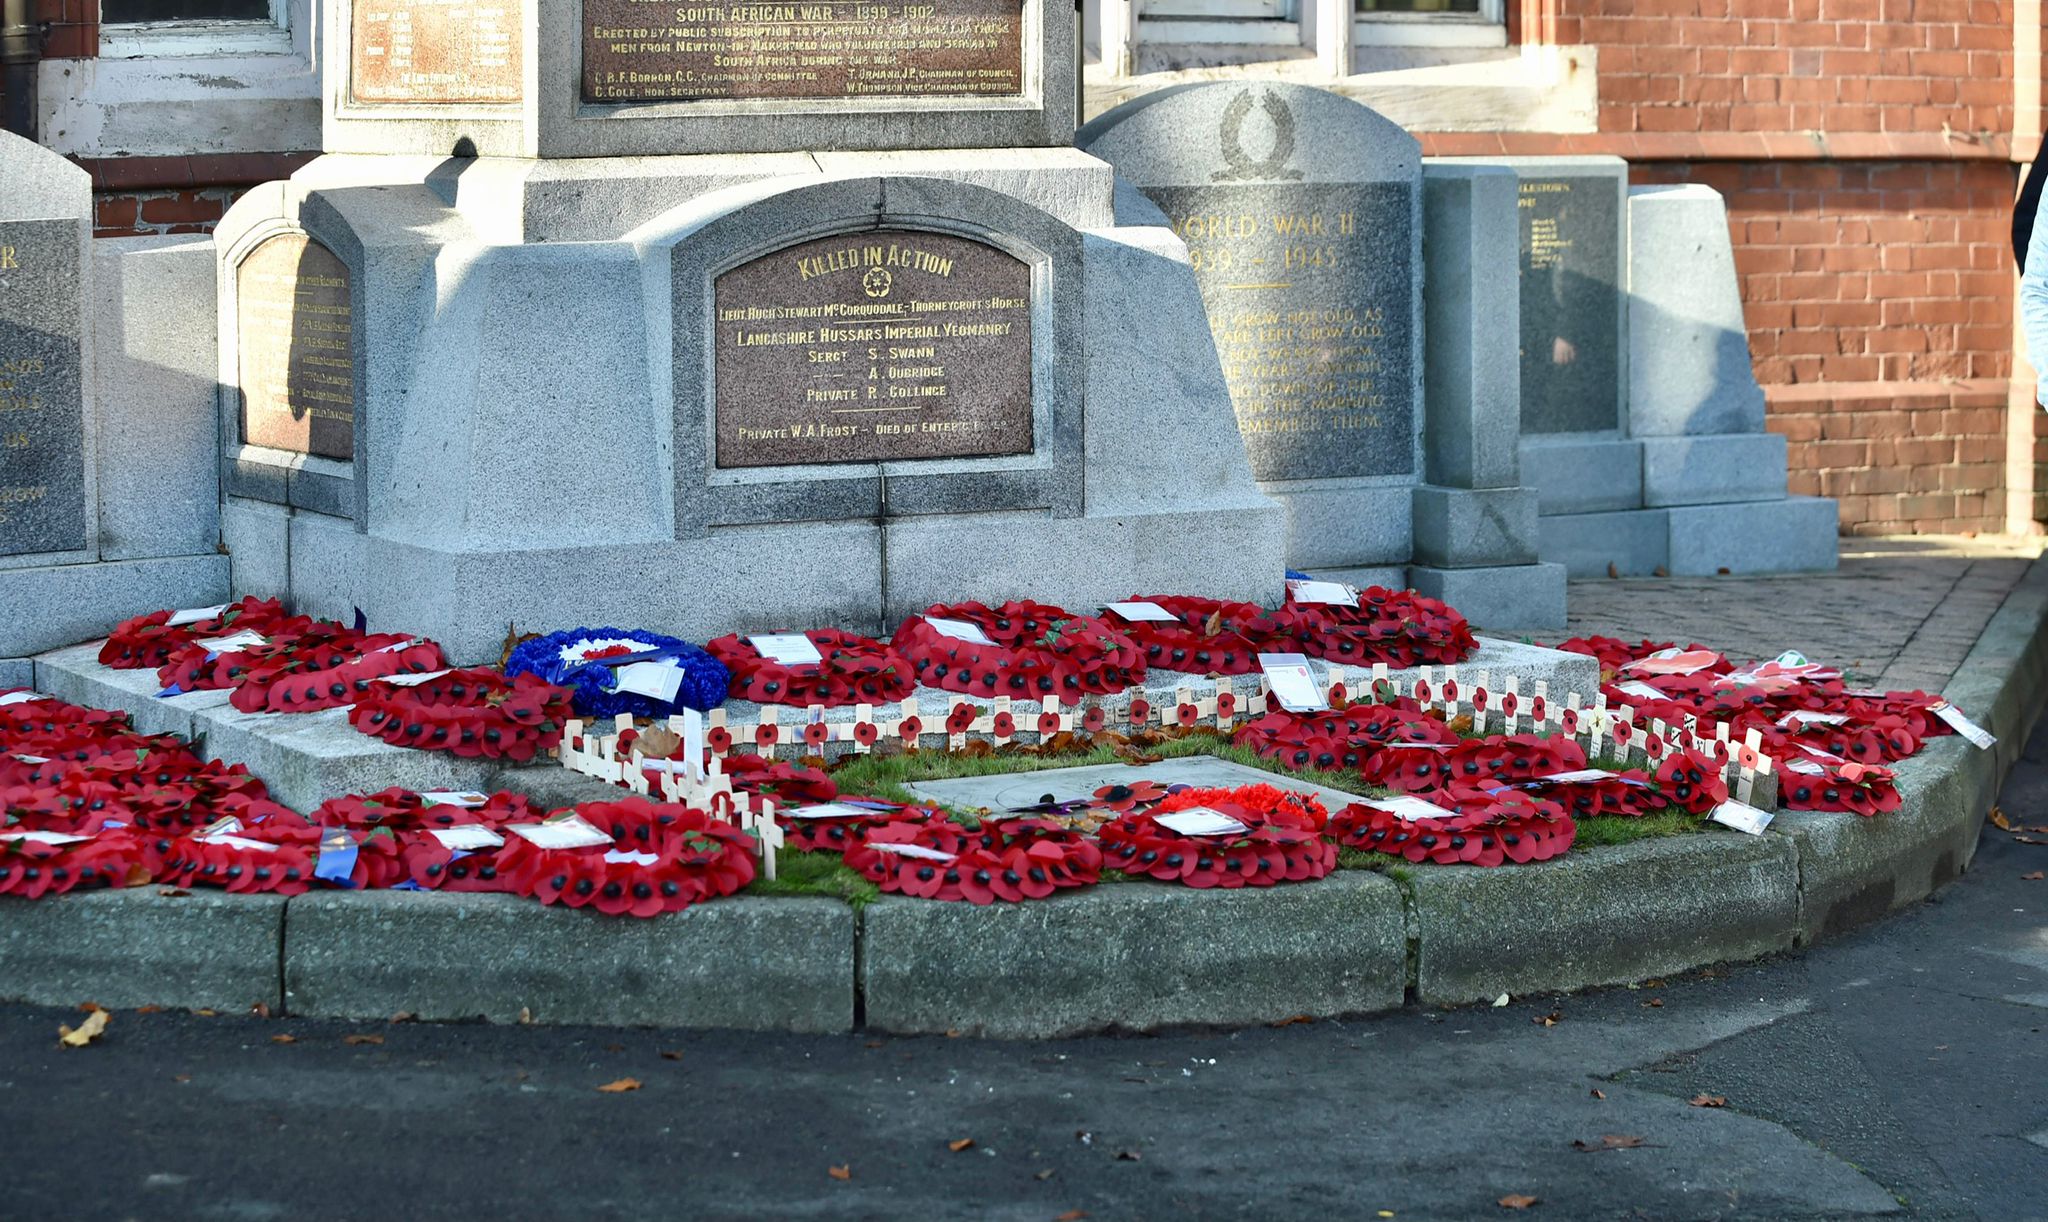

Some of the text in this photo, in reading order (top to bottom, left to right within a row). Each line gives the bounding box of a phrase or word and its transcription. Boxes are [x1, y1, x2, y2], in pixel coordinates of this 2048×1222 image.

[676, 7, 725, 22] SOUTH
[731, 6, 795, 21] AFRICAN
[801, 6, 833, 21] WAR
[856, 5, 888, 20] 1899
[903, 5, 936, 19] 1902
[594, 27, 648, 39] ERECTED
[650, 28, 666, 38] BY
[668, 27, 707, 38] PUBLIC
[710, 26, 791, 38] SUBSCRIPTION
[611, 43, 637, 54] MEN
[640, 43, 671, 53] FROM
[919, 39, 941, 48] AND
[713, 55, 752, 67] SOUTH
[756, 55, 797, 66] AFRICA
[801, 56, 843, 66] DURING
[848, 55, 868, 65] THE
[701, 72, 750, 82] CHAIRMAN
[919, 70, 964, 79] CHAIRMAN
[966, 70, 978, 78] OF
[924, 82, 968, 92] CHAIRMAN
[968, 83, 979, 91] OF
[1272, 213, 1327, 236] WAR
[1339, 211, 1354, 235] II
[798, 244, 953, 281] KILLED IN ACTION
[1284, 245, 1338, 269] 1945
[776, 306, 823, 319] STEWART
[992, 297, 1026, 309] HORSE
[1233, 312, 1280, 327] GROW
[1287, 311, 1316, 324] NOT
[1364, 308, 1383, 321] AS
[737, 322, 1012, 347] LANCASHIRE HUSSARS IMPERIAL YEOMANRY
[1222, 331, 1250, 344] ARE
[1259, 328, 1294, 342] LEFT
[1302, 327, 1345, 340] GROW
[888, 347, 935, 360] SWANN
[888, 366, 945, 379] OUBRIDGE
[1252, 363, 1297, 377] YEARS
[807, 389, 858, 402] PRIVATE
[889, 385, 946, 398] COLLINGE
[1259, 383, 1309, 397] DOWN
[1315, 381, 1336, 394] OF
[1348, 380, 1373, 392] THE
[1248, 401, 1266, 414] IN
[1274, 400, 1305, 413] THE
[1311, 395, 1384, 410] MORNING
[738, 428, 788, 440] PRIVATE
[876, 424, 901, 435] DIED
[904, 424, 918, 434] OF
[1239, 418, 1323, 434] EMEMBER
